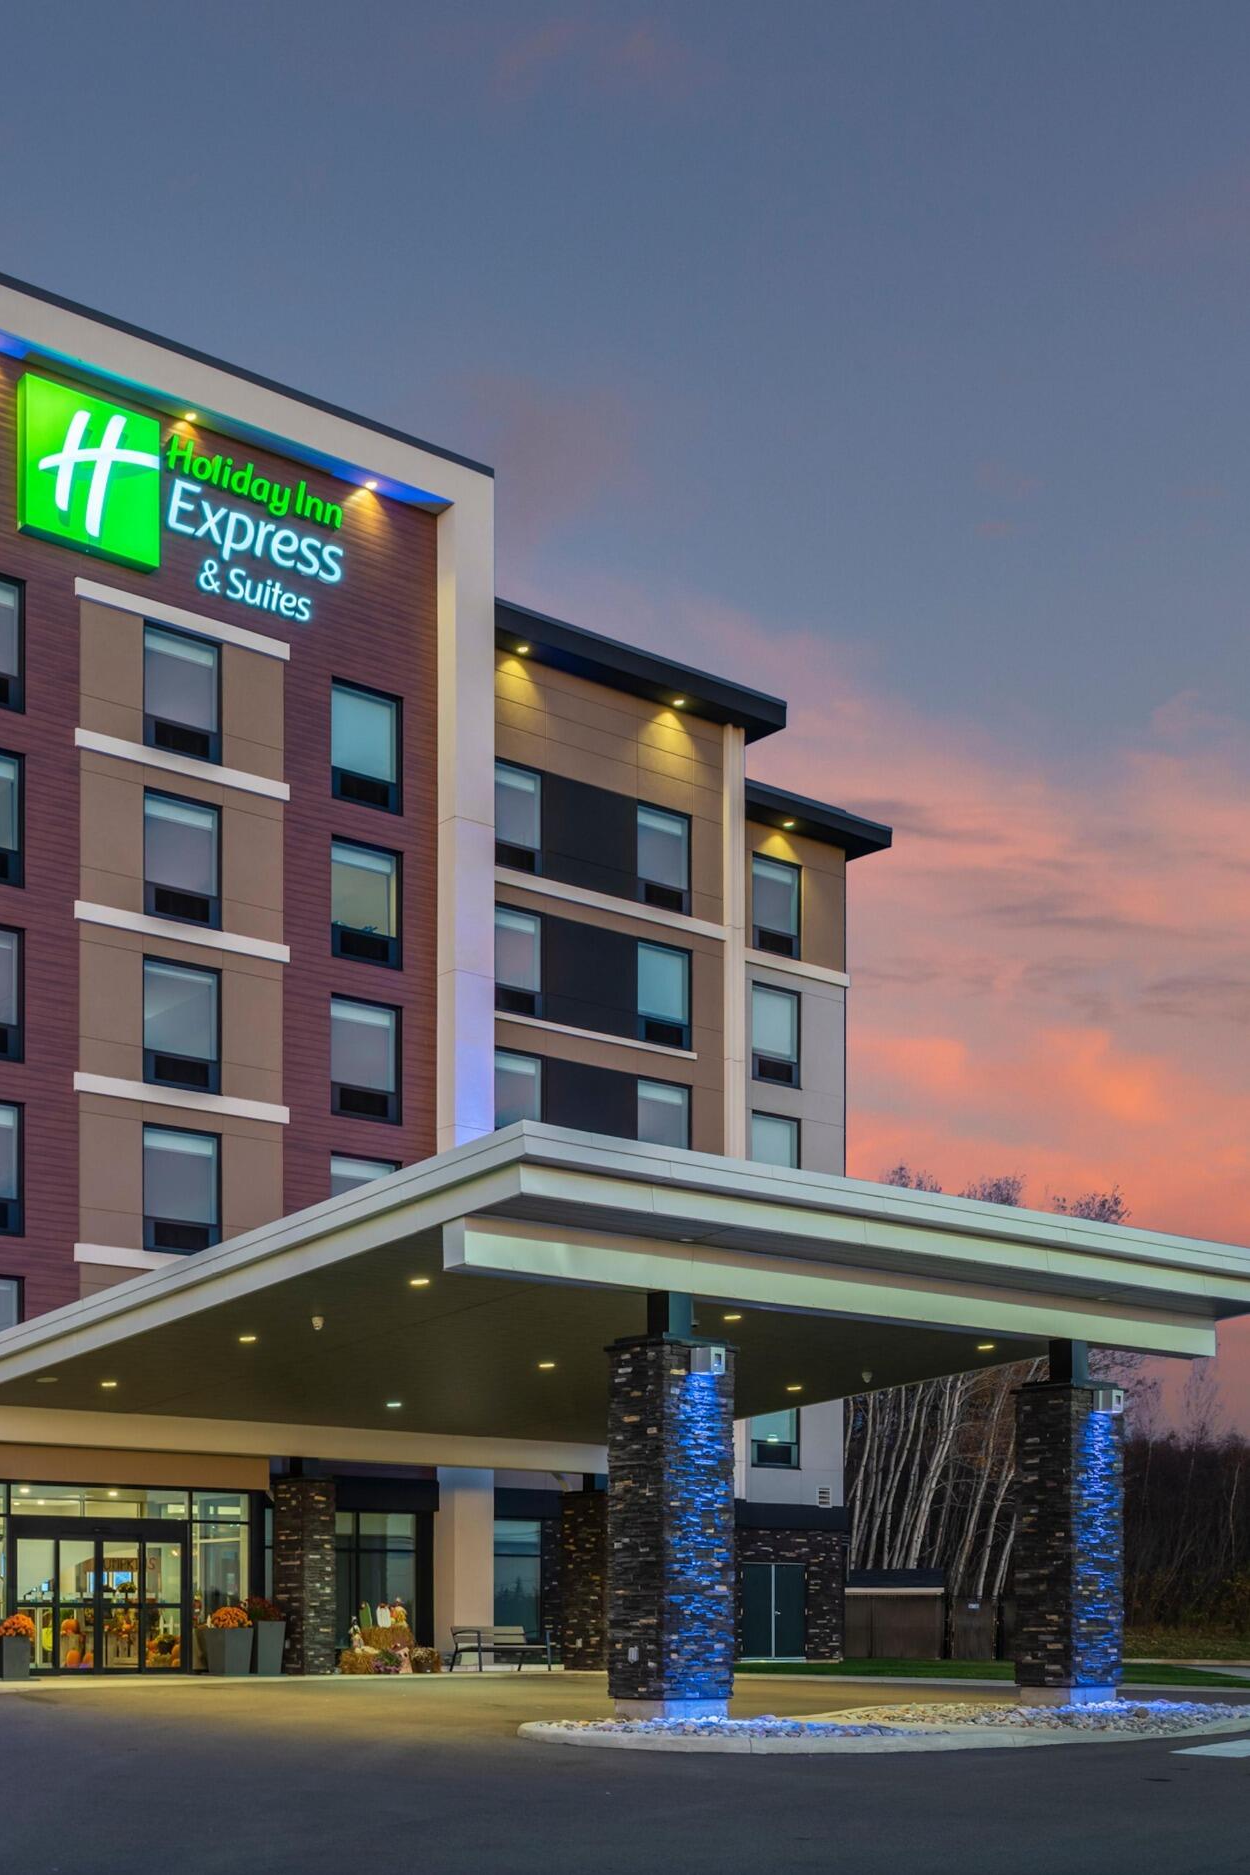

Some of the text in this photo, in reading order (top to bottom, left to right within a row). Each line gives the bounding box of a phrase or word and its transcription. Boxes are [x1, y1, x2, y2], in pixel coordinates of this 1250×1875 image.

[166, 434, 344, 530] Holiday Inn
[167, 478, 344, 583] Express
[198, 559, 312, 622] & Suites
